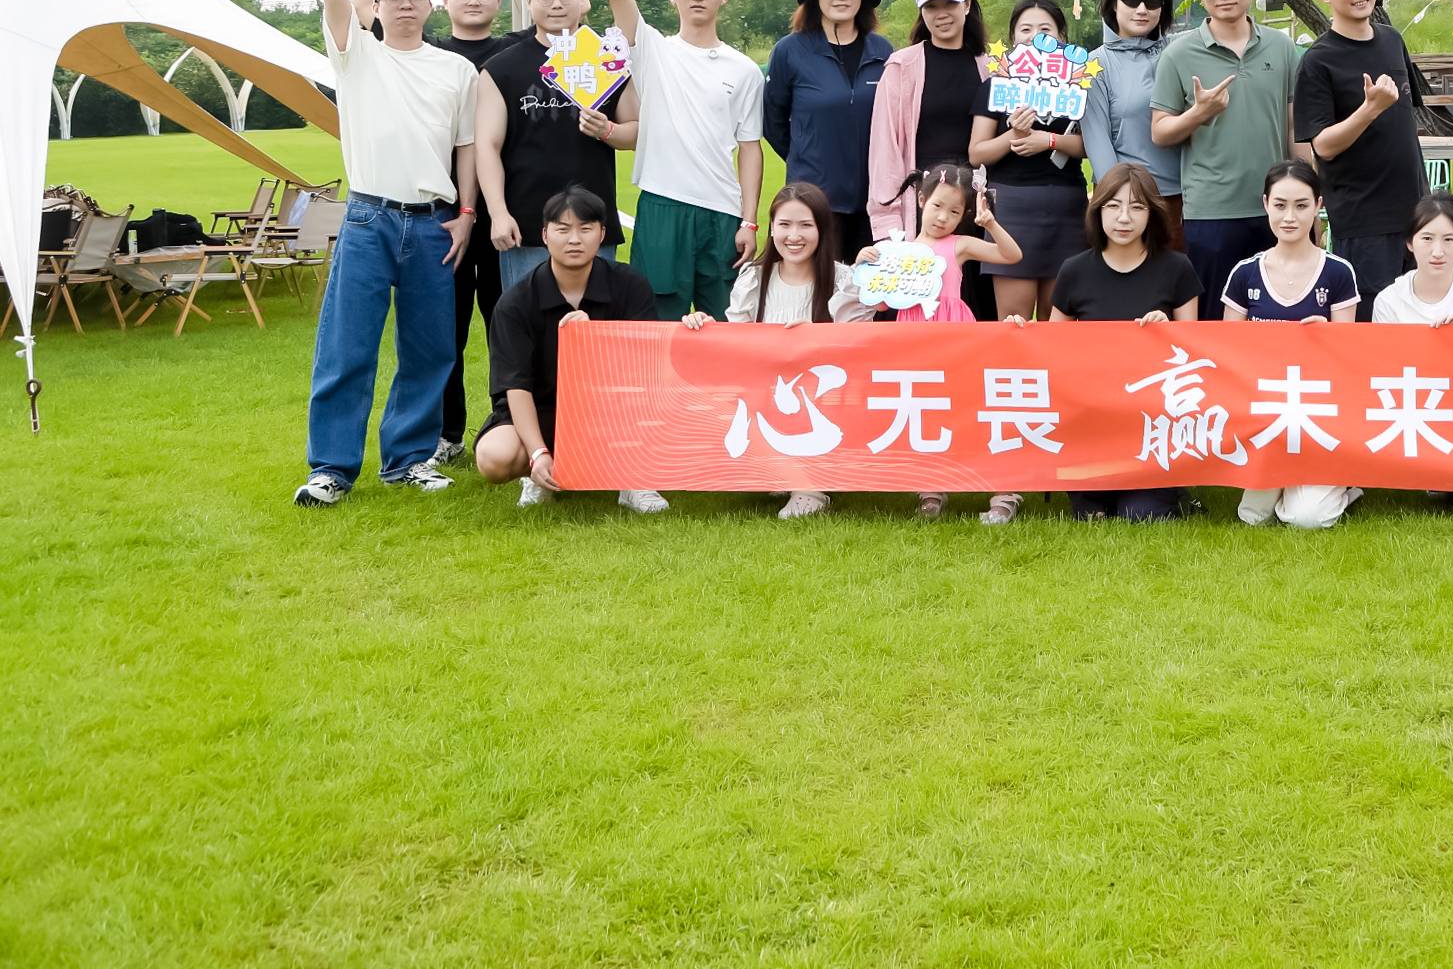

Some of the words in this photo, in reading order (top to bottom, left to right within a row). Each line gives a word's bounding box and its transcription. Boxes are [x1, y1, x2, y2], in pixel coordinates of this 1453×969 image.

[564, 62, 598, 95] 鸭
[1013, 48, 1070, 80] 公司
[993, 83, 1082, 116] 醉帅的
[1247, 288, 1261, 301] 08
[723, 365, 1063, 459] 心无畏
